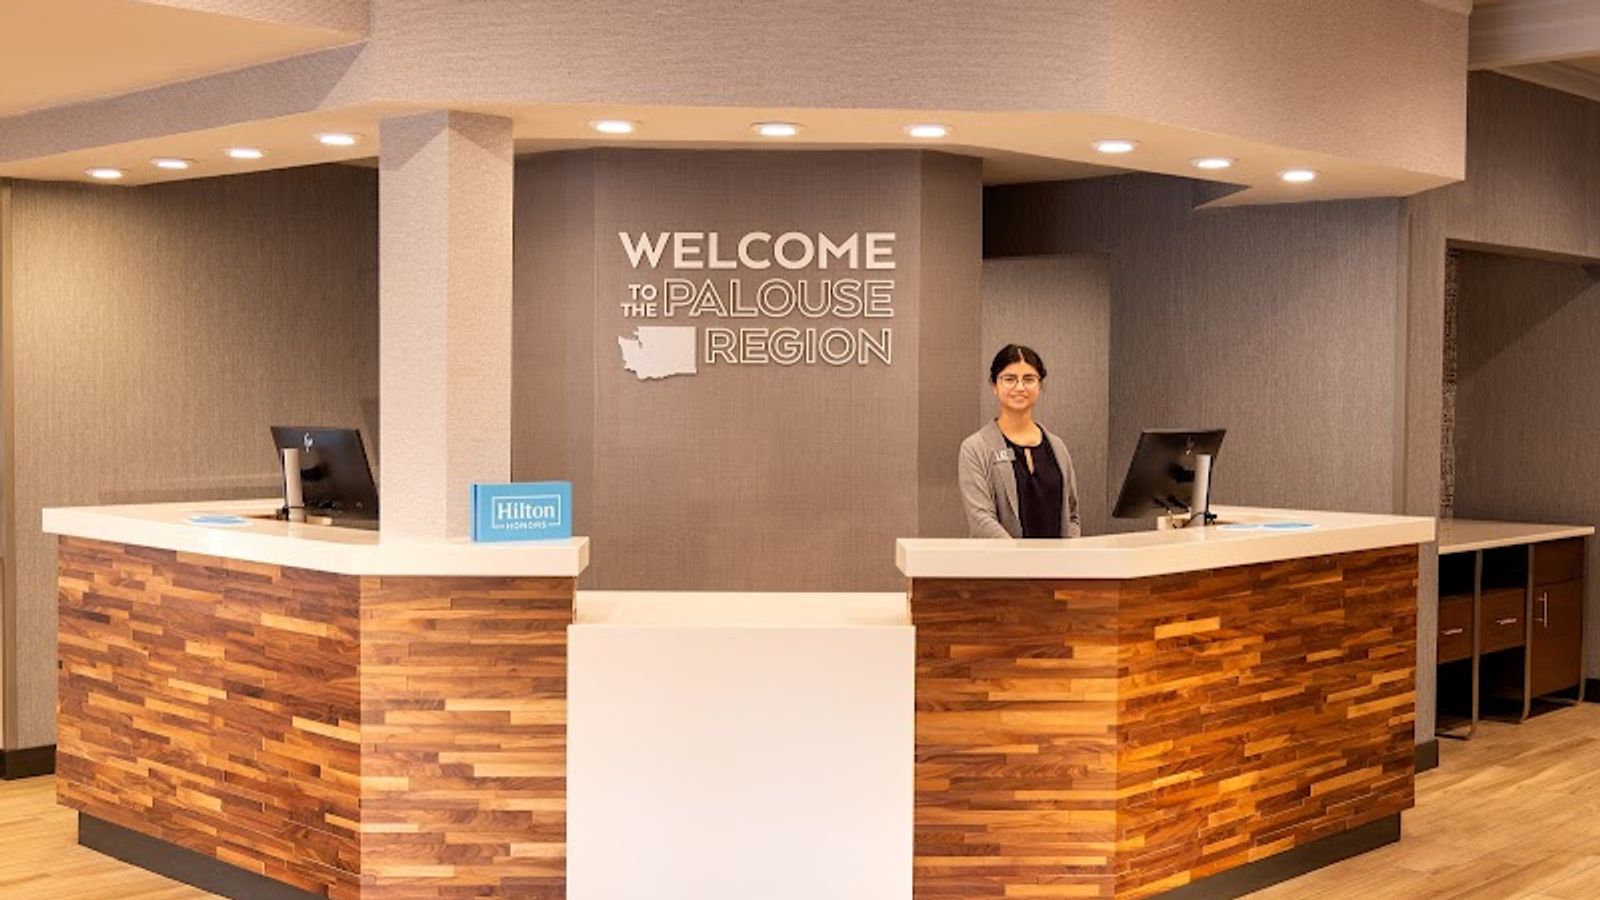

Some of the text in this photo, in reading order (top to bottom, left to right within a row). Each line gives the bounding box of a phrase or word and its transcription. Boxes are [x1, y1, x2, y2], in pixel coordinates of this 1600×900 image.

[618, 232, 896, 270] WELCOME
[628, 284, 657, 300] TO
[663, 278, 895, 318] PALOUSE
[621, 303, 657, 318] THE
[705, 327, 892, 365] REGION
[497, 502, 555, 519] Hilton
[505, 520, 547, 530] HONORS
